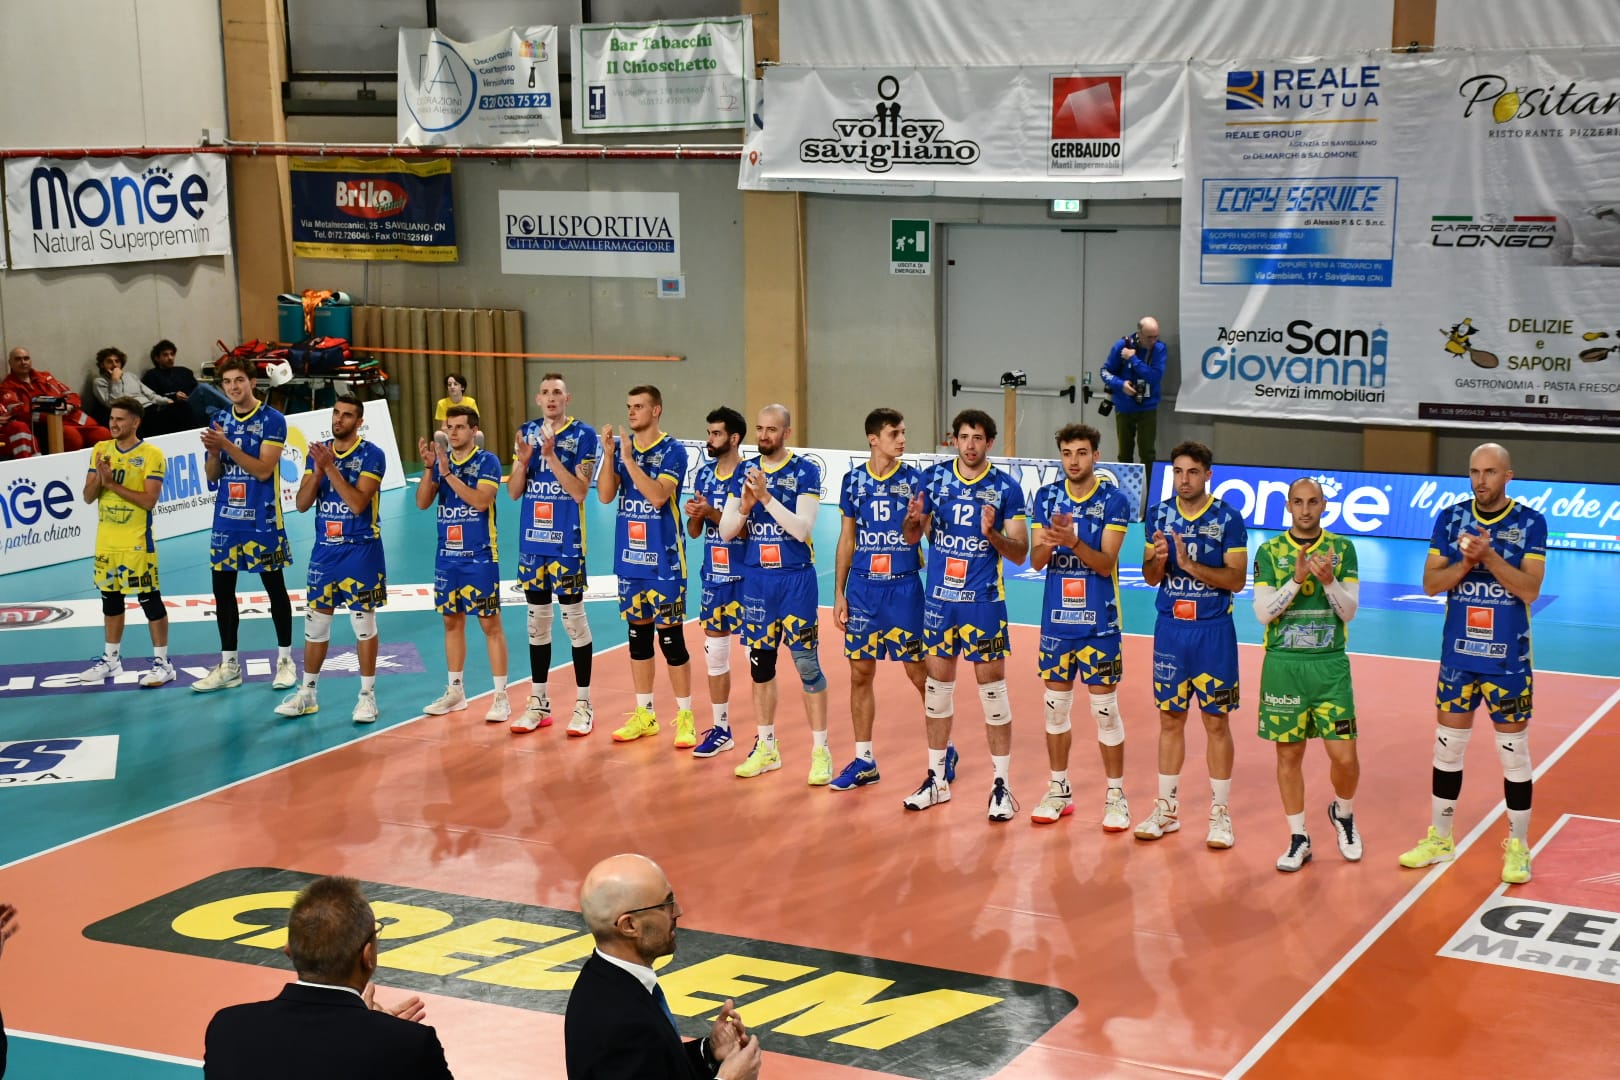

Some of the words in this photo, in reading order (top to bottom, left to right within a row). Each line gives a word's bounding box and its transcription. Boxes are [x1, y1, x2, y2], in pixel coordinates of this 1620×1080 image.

[610, 37, 638, 52] Bar
[643, 33, 712, 50] Tabacchi
[606, 61, 618, 74] Il
[623, 57, 717, 74] Chioschetto
[1274, 66, 1381, 90] REALE
[517, 94, 531, 107] 75
[532, 93, 548, 107] 22
[1274, 92, 1379, 109] MUTUA
[838, 112, 938, 143] volley
[1225, 131, 1260, 140] REALE
[1263, 130, 1302, 139] GROUP
[1488, 129, 1564, 138] RISTORANTE
[804, 140, 976, 169] savigliano
[1051, 142, 1121, 158] GERBAUDO
[1307, 151, 1359, 159] SALOMONE
[1074, 160, 1120, 171] impermeabili
[335, 181, 394, 209] Briko
[1215, 187, 1282, 212] COPY
[1285, 186, 1382, 212] SERVICE
[300, 219, 313, 228] Via
[369, 220, 379, 230] 25
[506, 215, 673, 238] POLISPORTIVA
[1304, 218, 1312, 227] di
[1312, 218, 1340, 227] Alessio
[33, 229, 95, 253] Natural
[375, 232, 391, 241] Fax
[1432, 235, 1554, 249] LONGO
[1307, 272, 1317, 280] 17
[1324, 272, 1366, 283] Savigliano
[1508, 318, 1574, 334] DELIZIE
[1217, 326, 1284, 346] Agenzia
[1285, 319, 1369, 357] San
[1535, 340, 1545, 350] e
[1507, 355, 1571, 372] SAPORI
[1254, 384, 1300, 399] Servizi
[1304, 386, 1385, 403] immobiliari
[1455, 378, 1534, 390] GASTRONOMIA
[1543, 380, 1576, 392] PASTA
[1579, 381, 1620, 393] FRESCA
[157, 500, 191, 517] Risparmio
[869, 500, 891, 521] 15
[1551, 487, 1601, 518] che
[951, 503, 975, 527] 12
[5, 527, 42, 553] parla
[43, 523, 82, 542] chiaro
